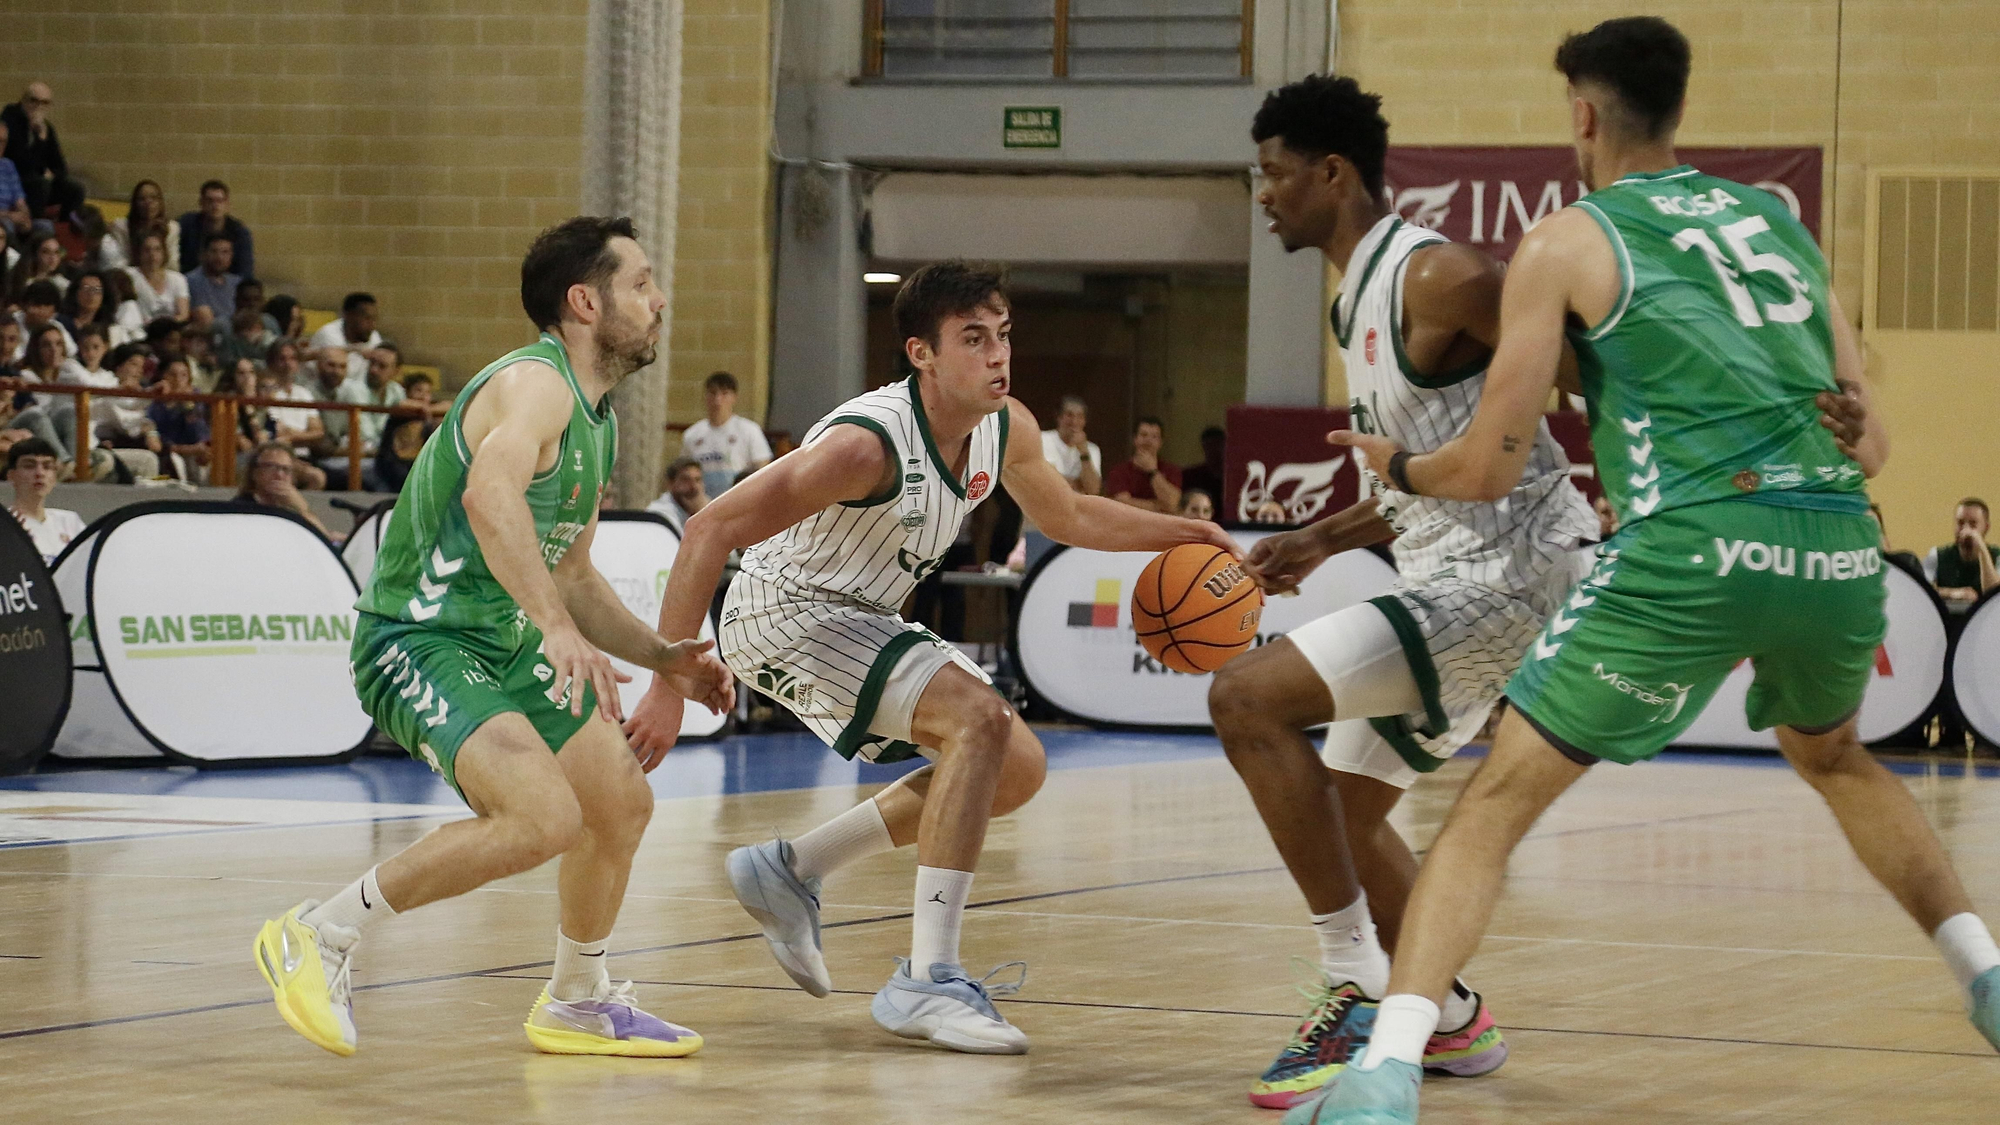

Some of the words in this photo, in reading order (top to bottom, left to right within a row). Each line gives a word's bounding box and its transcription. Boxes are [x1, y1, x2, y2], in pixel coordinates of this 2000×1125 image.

[1650, 187, 1742, 217] ROSA
[1671, 214, 1814, 327] 15
[1714, 537, 1796, 577] you
[119, 614, 185, 644] SAN
[190, 613, 351, 642] SEBASTIAN
[798, 681, 808, 709] REALE
